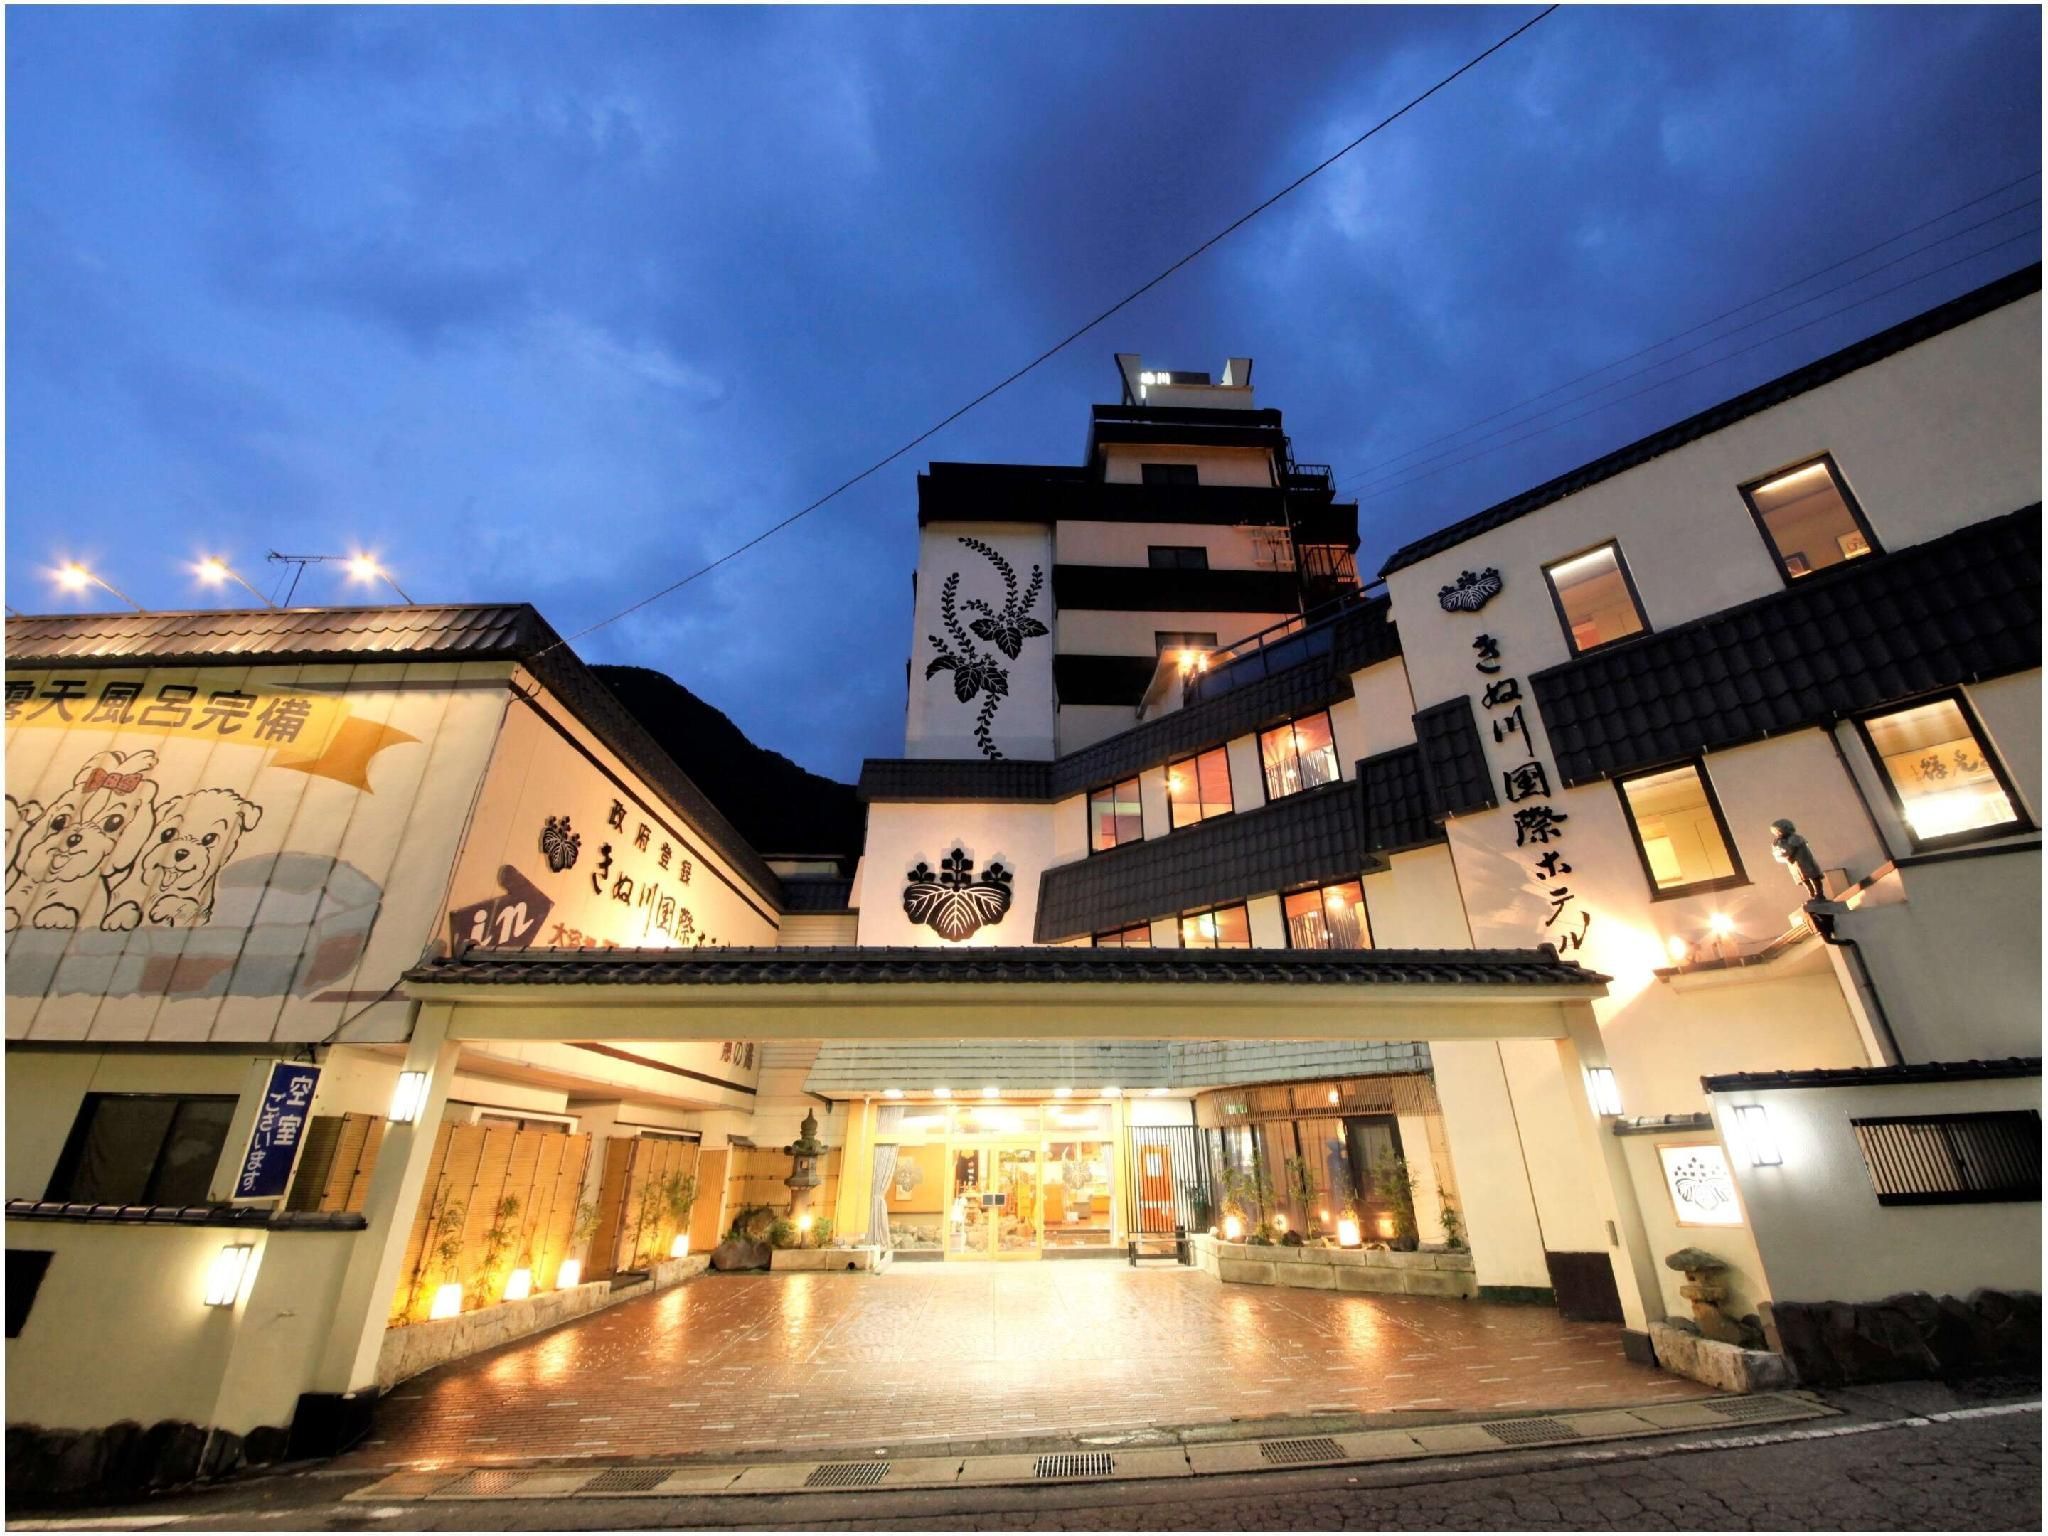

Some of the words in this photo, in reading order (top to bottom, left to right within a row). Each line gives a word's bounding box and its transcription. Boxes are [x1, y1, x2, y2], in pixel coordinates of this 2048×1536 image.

[1471, 633, 1591, 953] きぬ川国際ホテル
[608, 798, 693, 886] 政府登録
[273, 1075, 314, 1146] 空室
